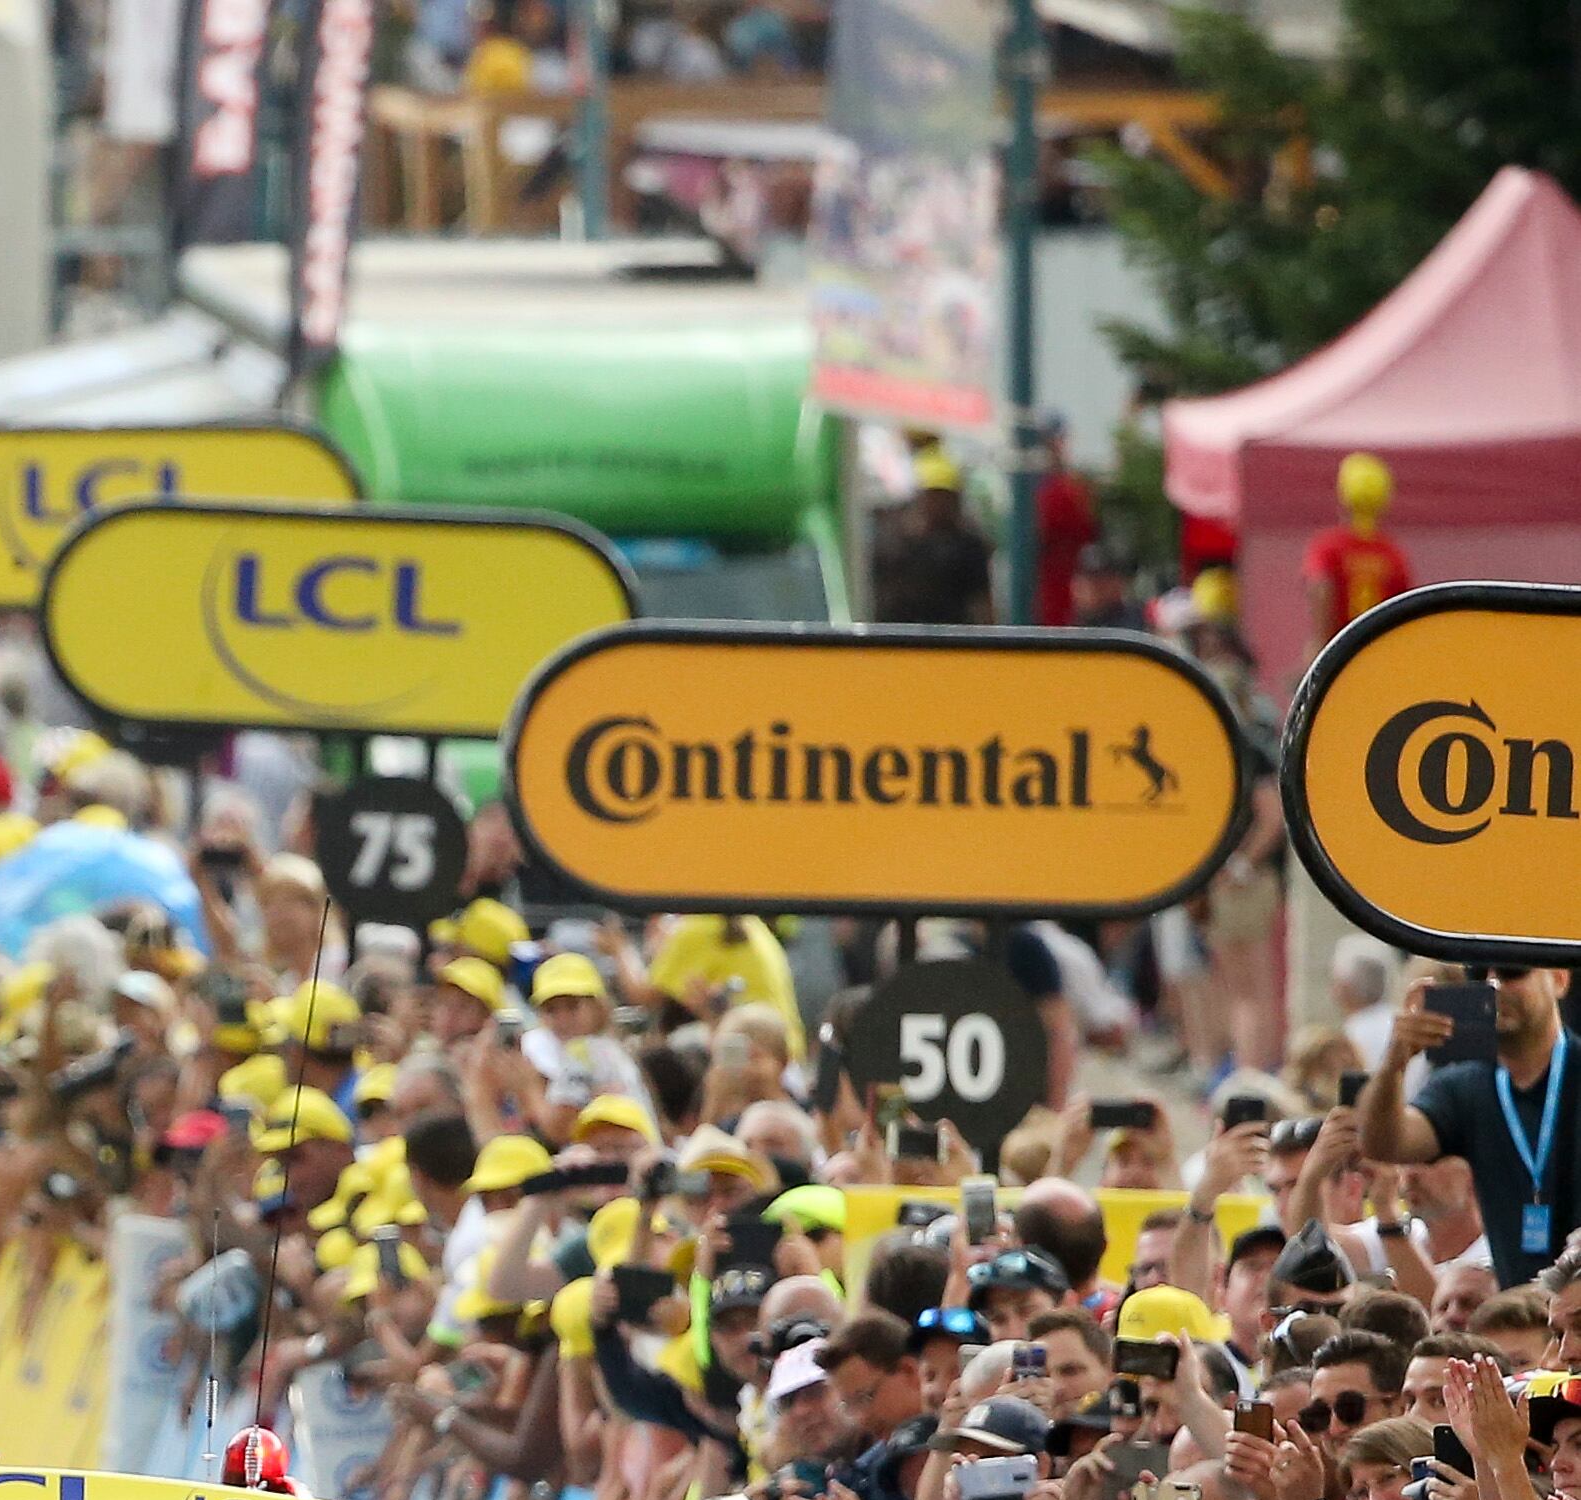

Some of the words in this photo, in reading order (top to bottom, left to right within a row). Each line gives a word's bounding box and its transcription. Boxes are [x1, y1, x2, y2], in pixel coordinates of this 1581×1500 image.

[237, 552, 463, 637] LCL
[564, 712, 1093, 825] Continental
[1364, 695, 1581, 846] Con
[350, 812, 436, 891] 75
[897, 1011, 1006, 1103] 50
